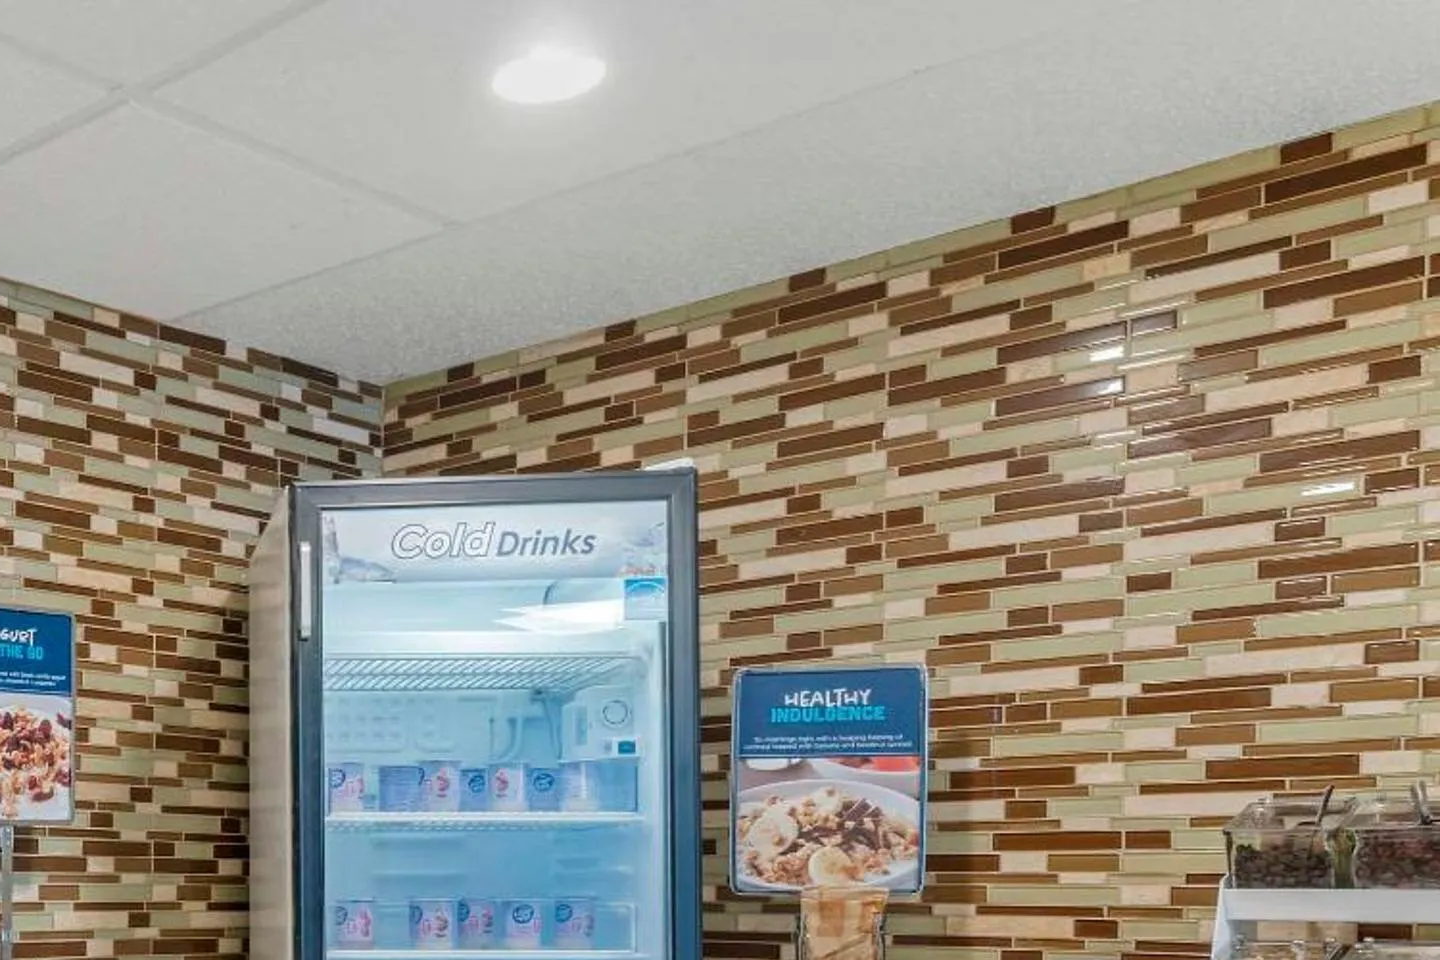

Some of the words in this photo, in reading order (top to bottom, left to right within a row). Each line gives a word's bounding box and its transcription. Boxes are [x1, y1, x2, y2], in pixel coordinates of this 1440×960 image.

[391, 521, 496, 560] Cold
[496, 528, 597, 557] Drinks
[27, 646, 44, 660] GO
[784, 688, 872, 708] HEALTHY
[770, 705, 886, 723] INDULGENCE
